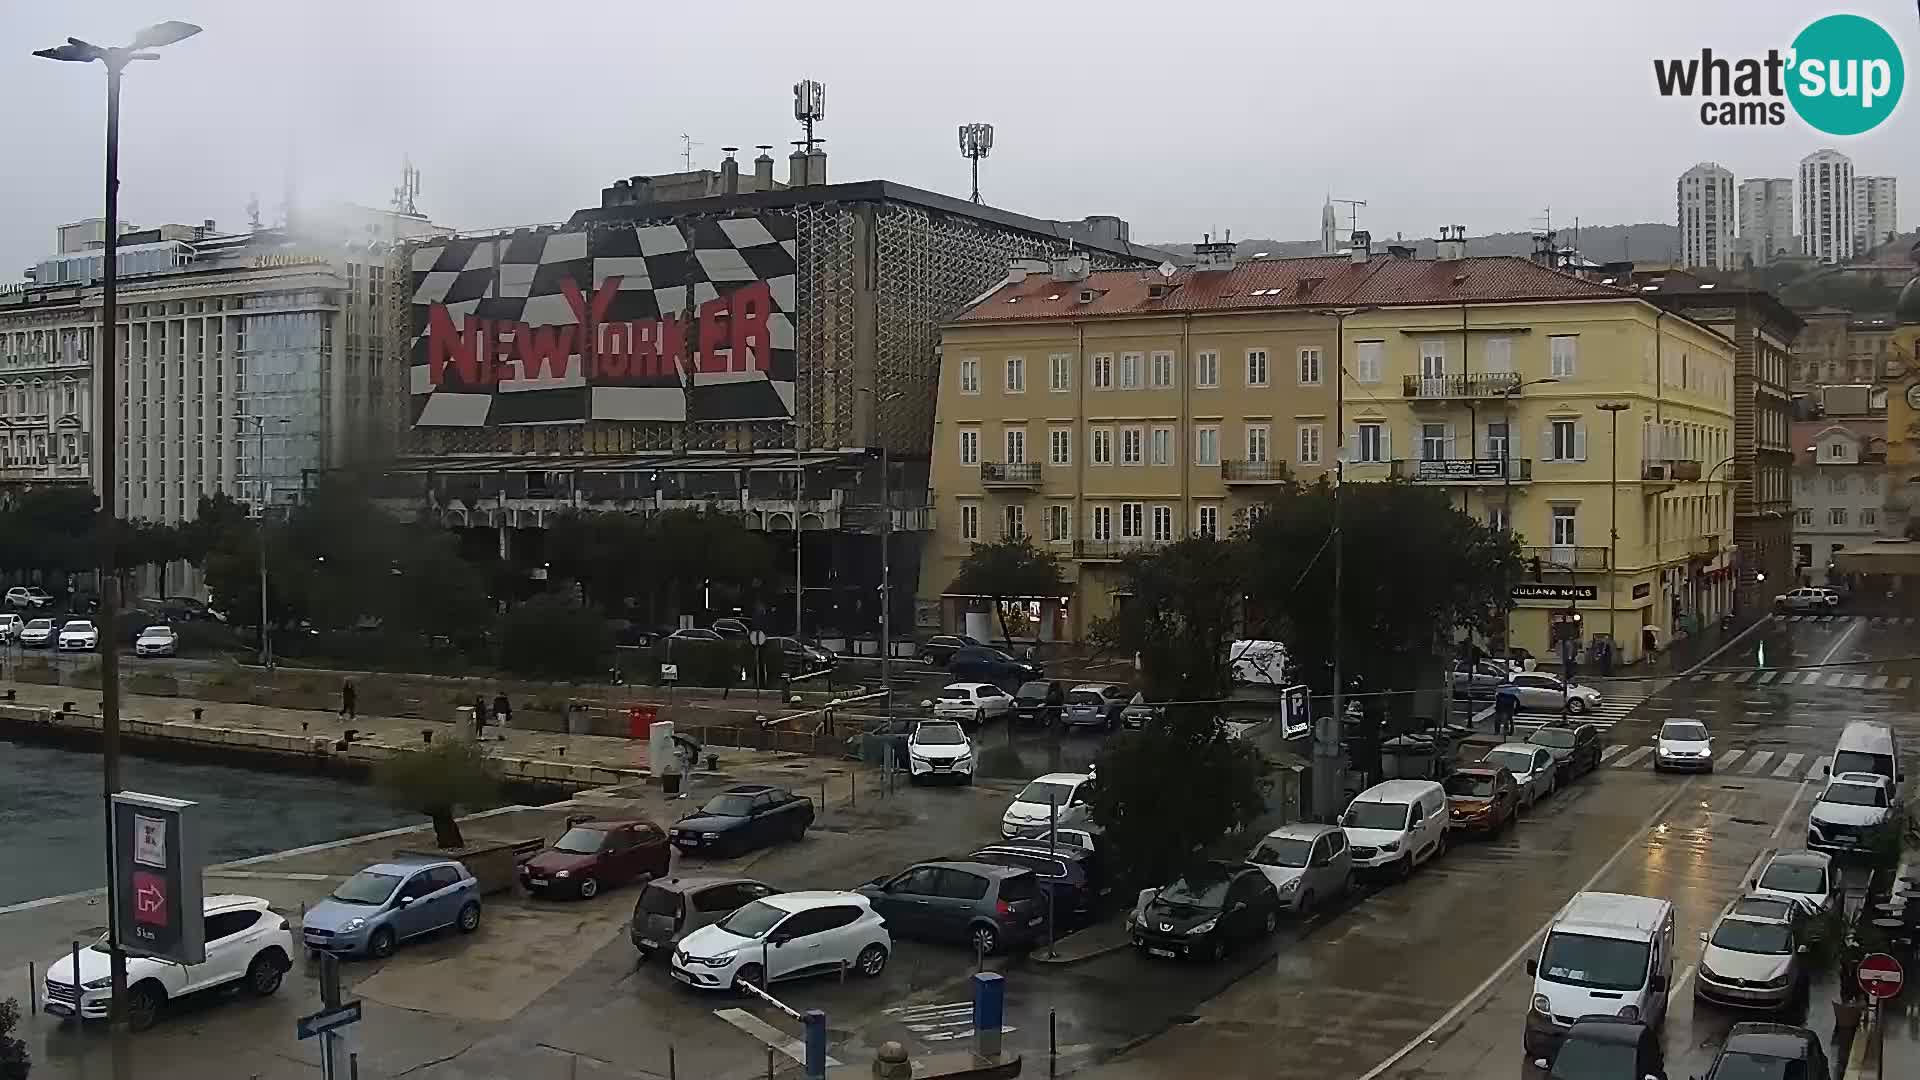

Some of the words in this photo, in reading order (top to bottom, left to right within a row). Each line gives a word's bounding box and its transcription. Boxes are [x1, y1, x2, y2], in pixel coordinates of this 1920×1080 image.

[429, 299, 575, 385] NEW
[561, 275, 771, 379] YORKER
[1512, 588, 1557, 596] JULIANA
